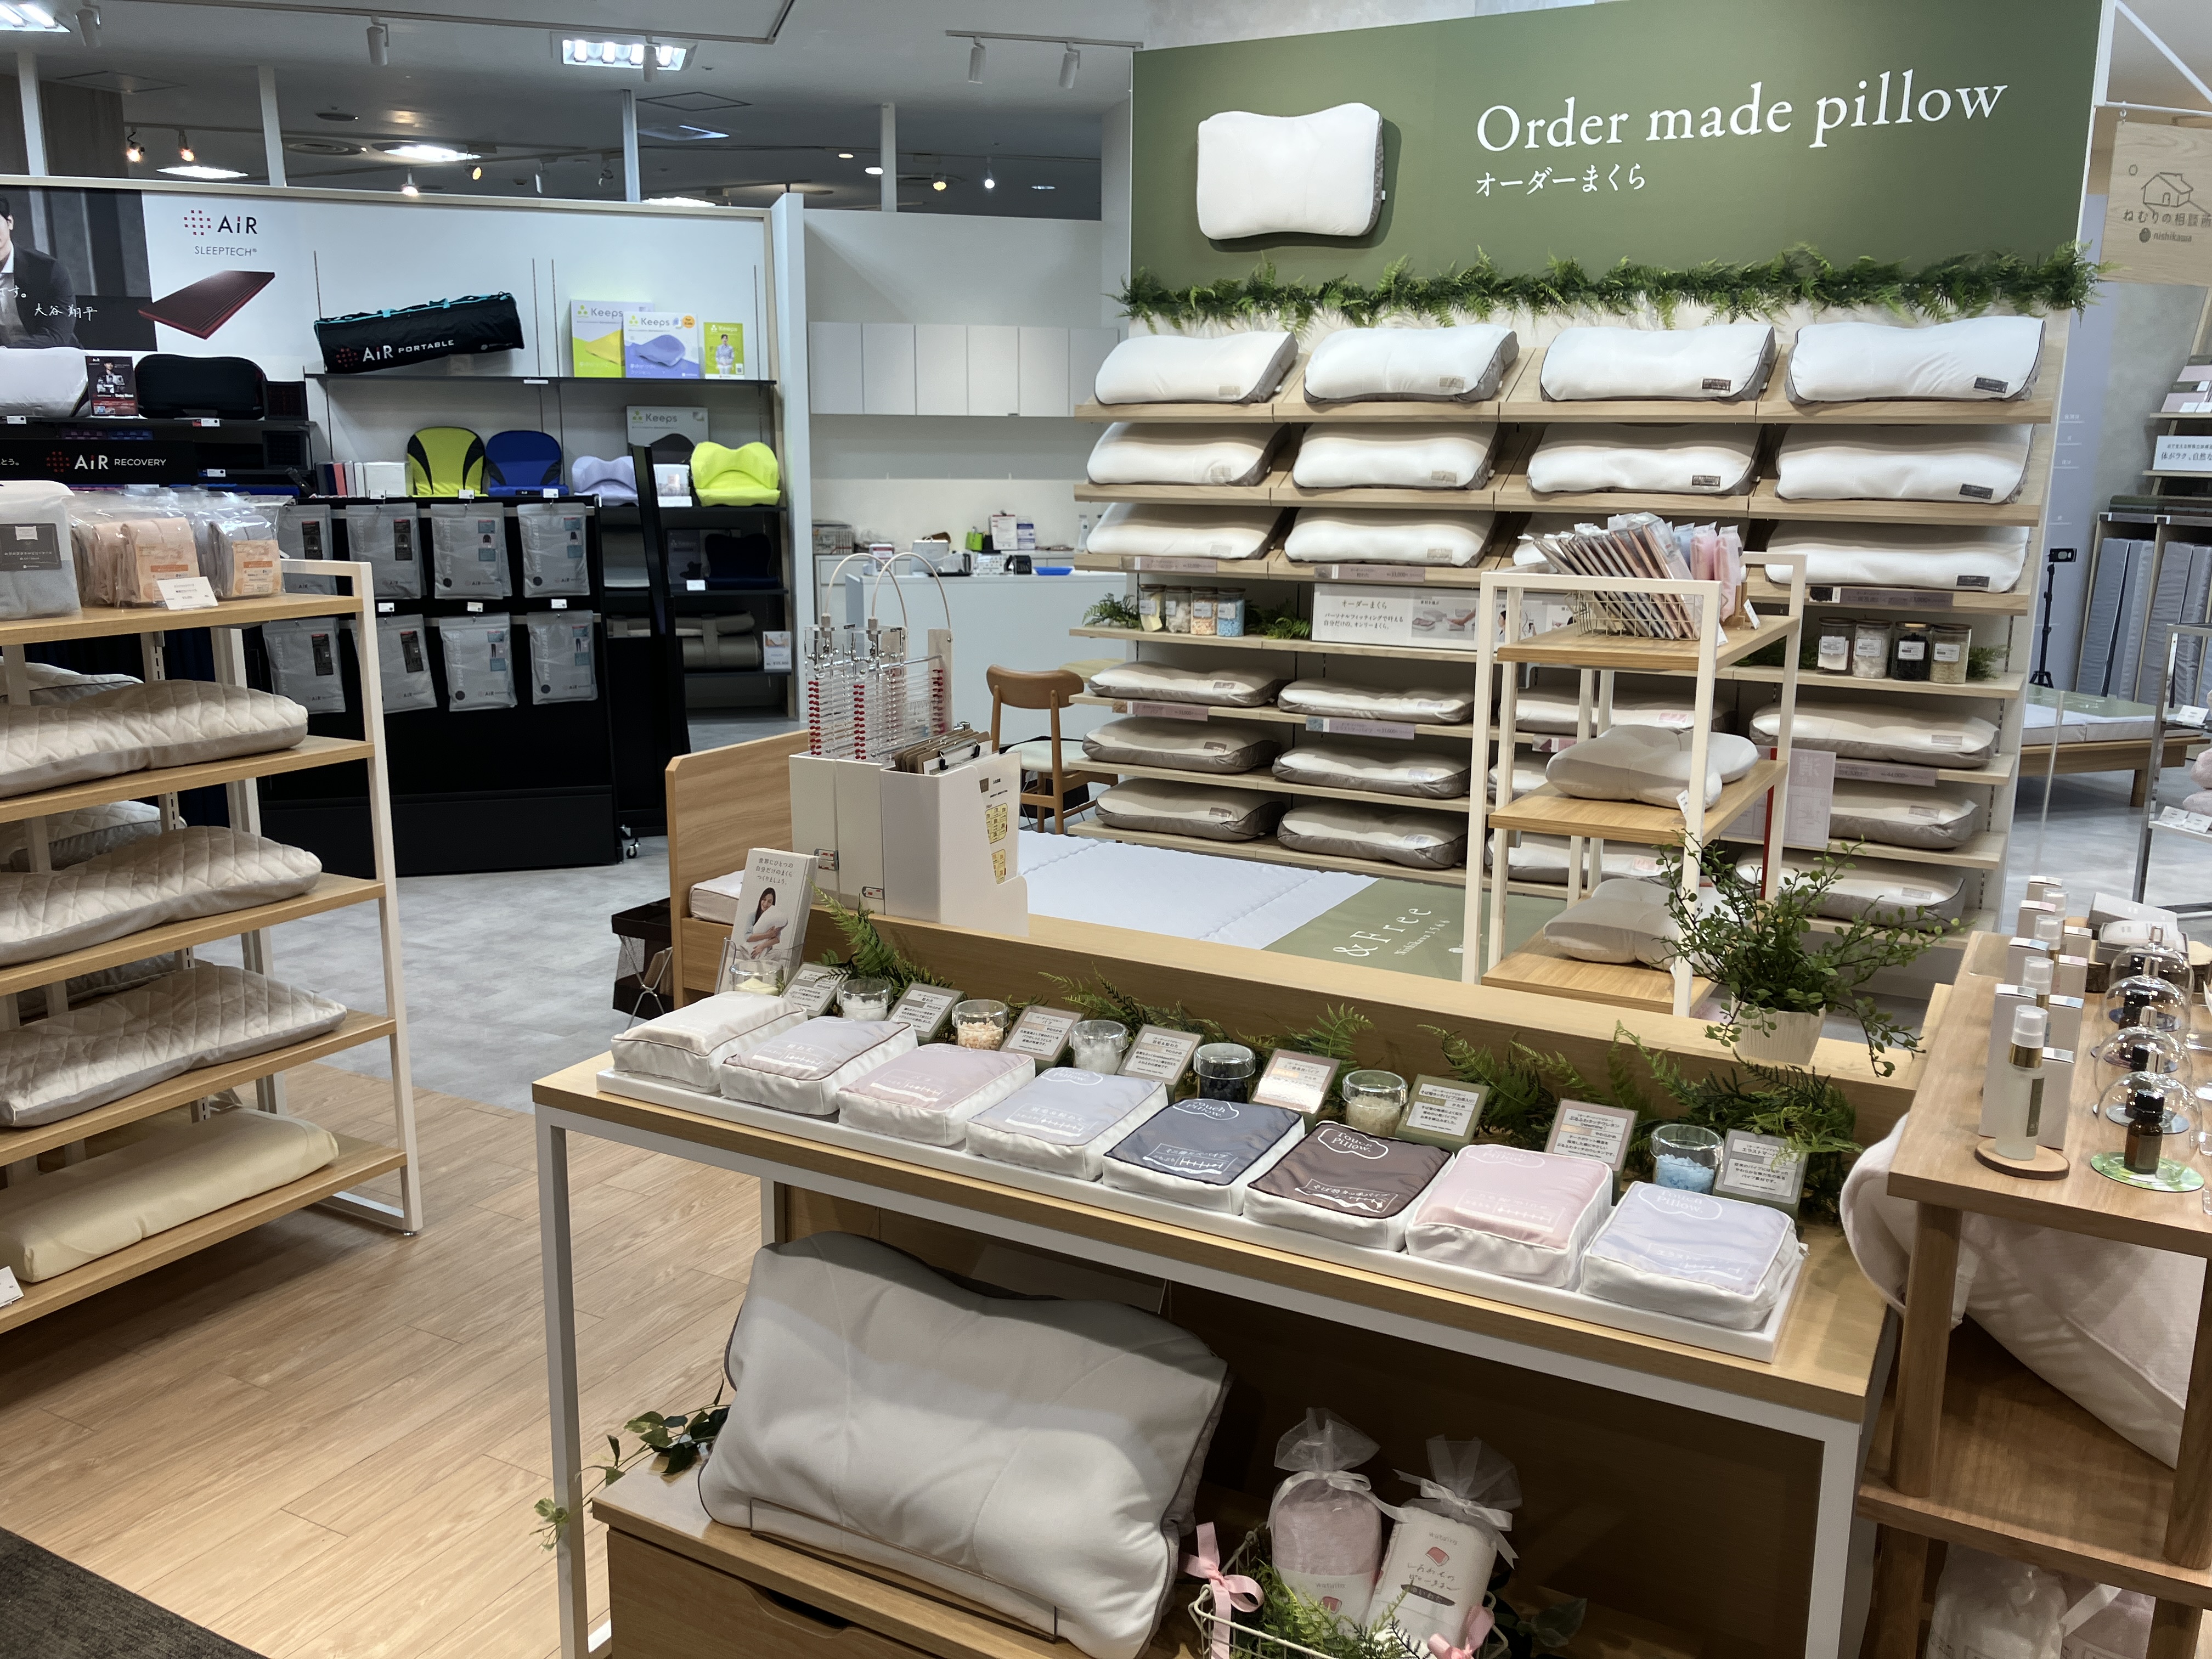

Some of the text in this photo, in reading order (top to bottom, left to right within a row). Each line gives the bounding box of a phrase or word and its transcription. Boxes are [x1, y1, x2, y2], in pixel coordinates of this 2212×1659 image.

[1477, 69, 2008, 151] Order made pillow
[1476, 163, 1646, 196] オーダーまくら
[2123, 209, 2212, 227] ねむりの相談所
[591, 308, 623, 318] Keeps
[641, 318, 670, 326] Keeps
[398, 340, 454, 354] PORTABLE
[645, 413, 678, 424] Keeps
[114, 458, 167, 466] RECOVERY
[1342, 599, 1387, 610] オーダーまくら
[759, 858, 793, 868] 世界にひとつの
[755, 866, 792, 877] 自分だけのまくら
[757, 875, 787, 885] つくりましょう。
[1734, 1163, 1789, 1176] 従来のパイプにはかった
